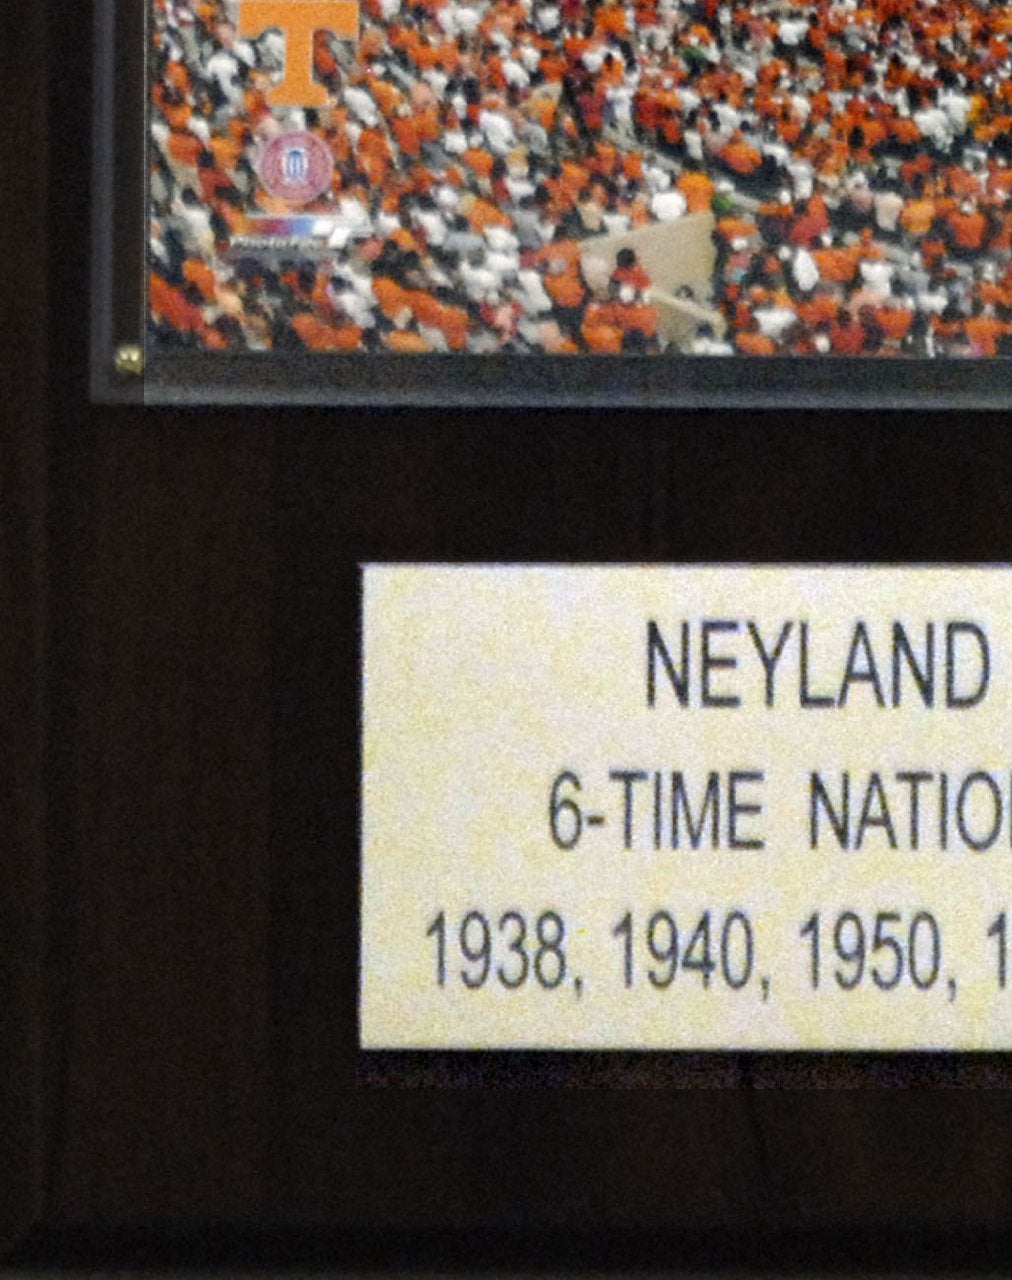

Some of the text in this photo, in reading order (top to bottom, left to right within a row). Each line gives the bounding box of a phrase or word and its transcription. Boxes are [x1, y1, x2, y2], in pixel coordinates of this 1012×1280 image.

[645, 619, 990, 709] NEYLAND
[548, 770, 765, 851] 6-TIME
[426, 909, 583, 1000] 1938,
[613, 909, 770, 1000] 1940,
[800, 910, 957, 1001] 1950,
